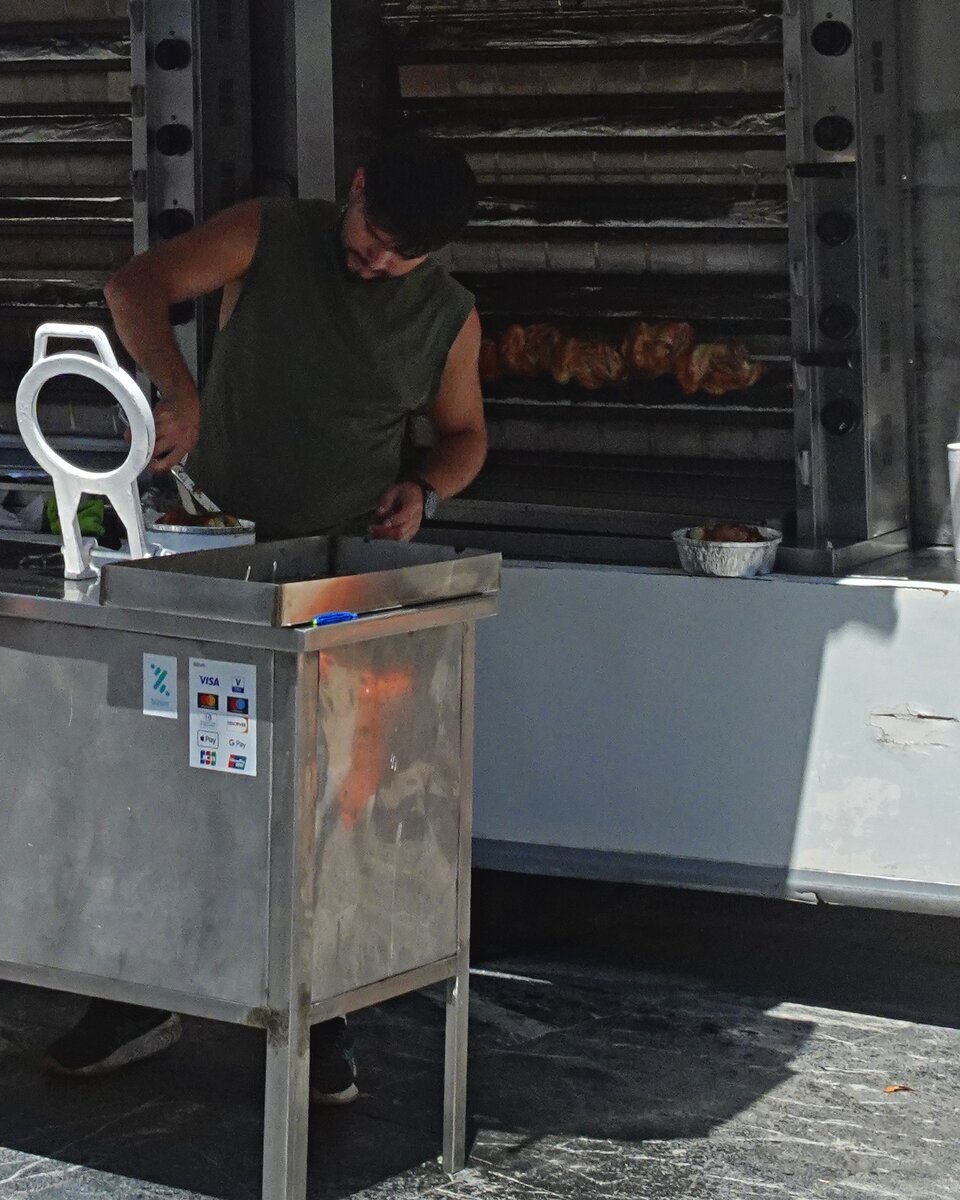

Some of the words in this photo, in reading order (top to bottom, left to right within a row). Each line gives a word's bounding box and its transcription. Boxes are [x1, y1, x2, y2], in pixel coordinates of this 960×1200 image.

[199, 675, 220, 687] VISA
[205, 735, 217, 746] Pay
[236, 740, 247, 749] Pay
